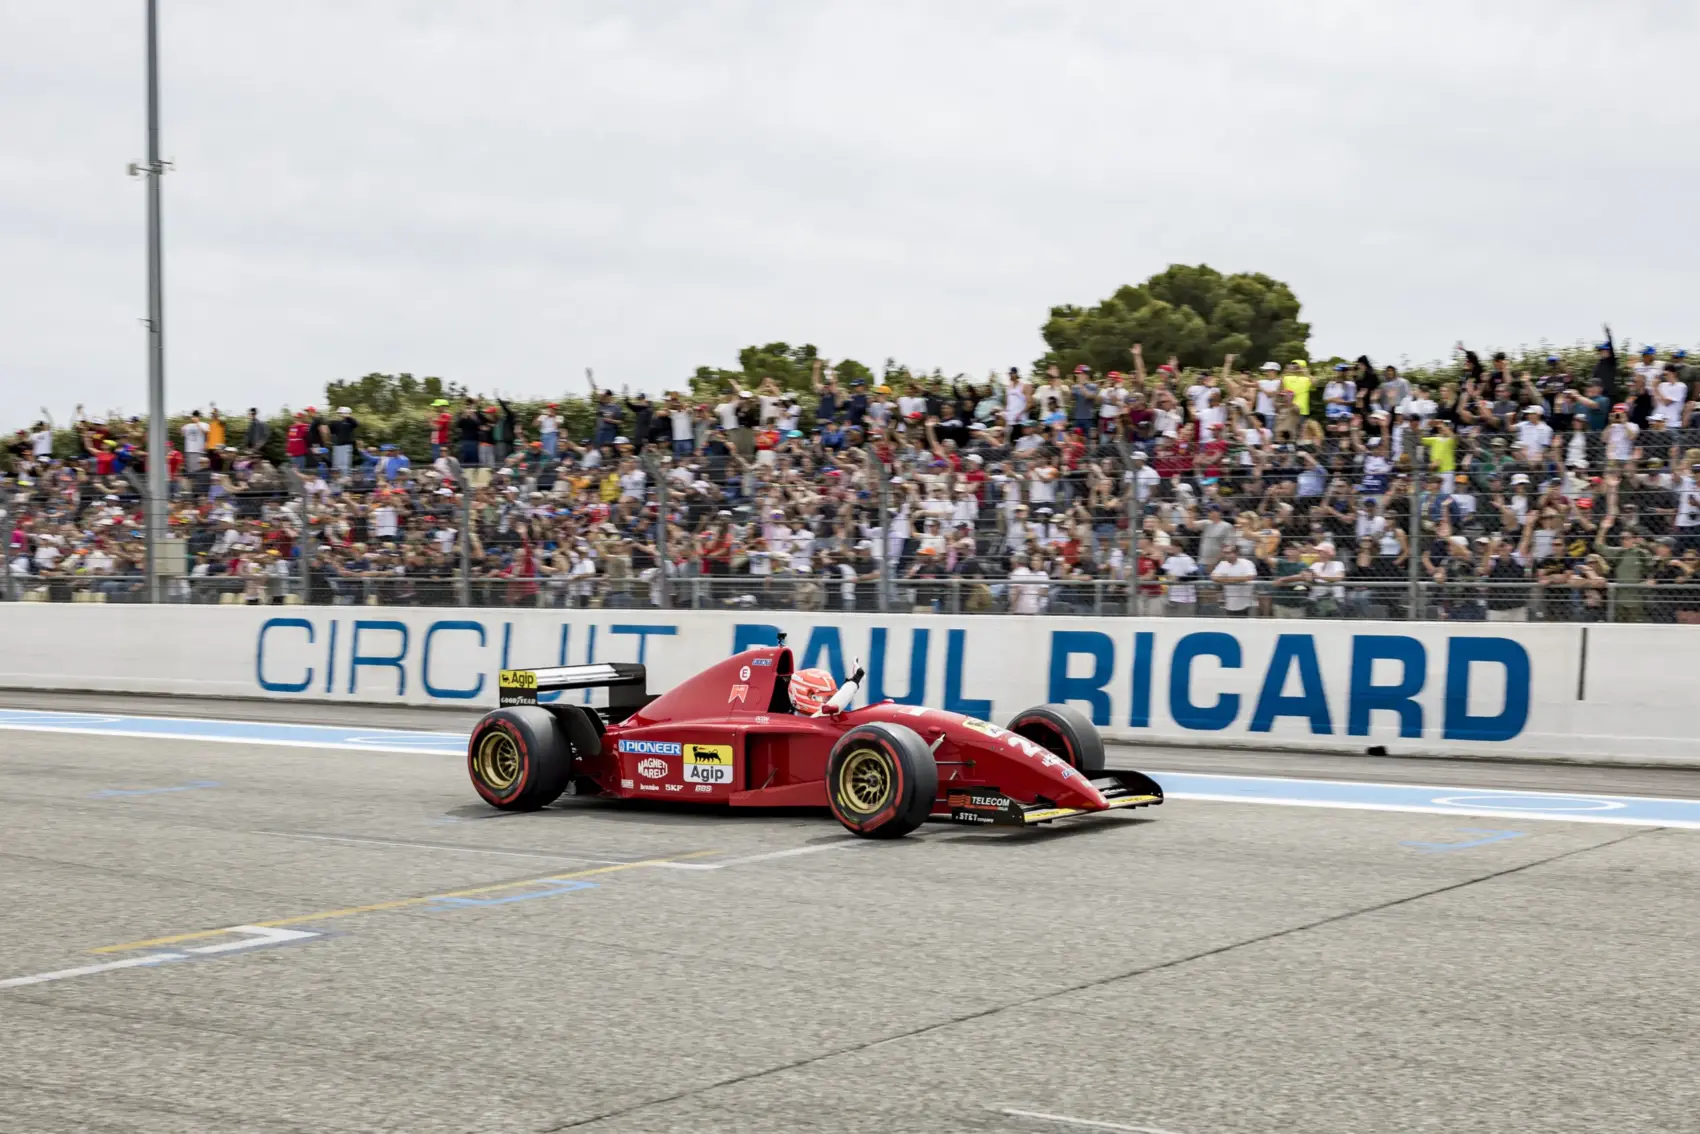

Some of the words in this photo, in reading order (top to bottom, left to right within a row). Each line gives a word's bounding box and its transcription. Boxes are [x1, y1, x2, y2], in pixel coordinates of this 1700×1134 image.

[511, 671, 534, 688] Agip
[742, 668, 749, 678] E
[1047, 630, 1532, 742] RICARD
[500, 696, 536, 705] GOODYEAR
[626, 741, 681, 754] PIONEER
[690, 765, 724, 782] Agip
[971, 796, 1010, 807] TELECOM
